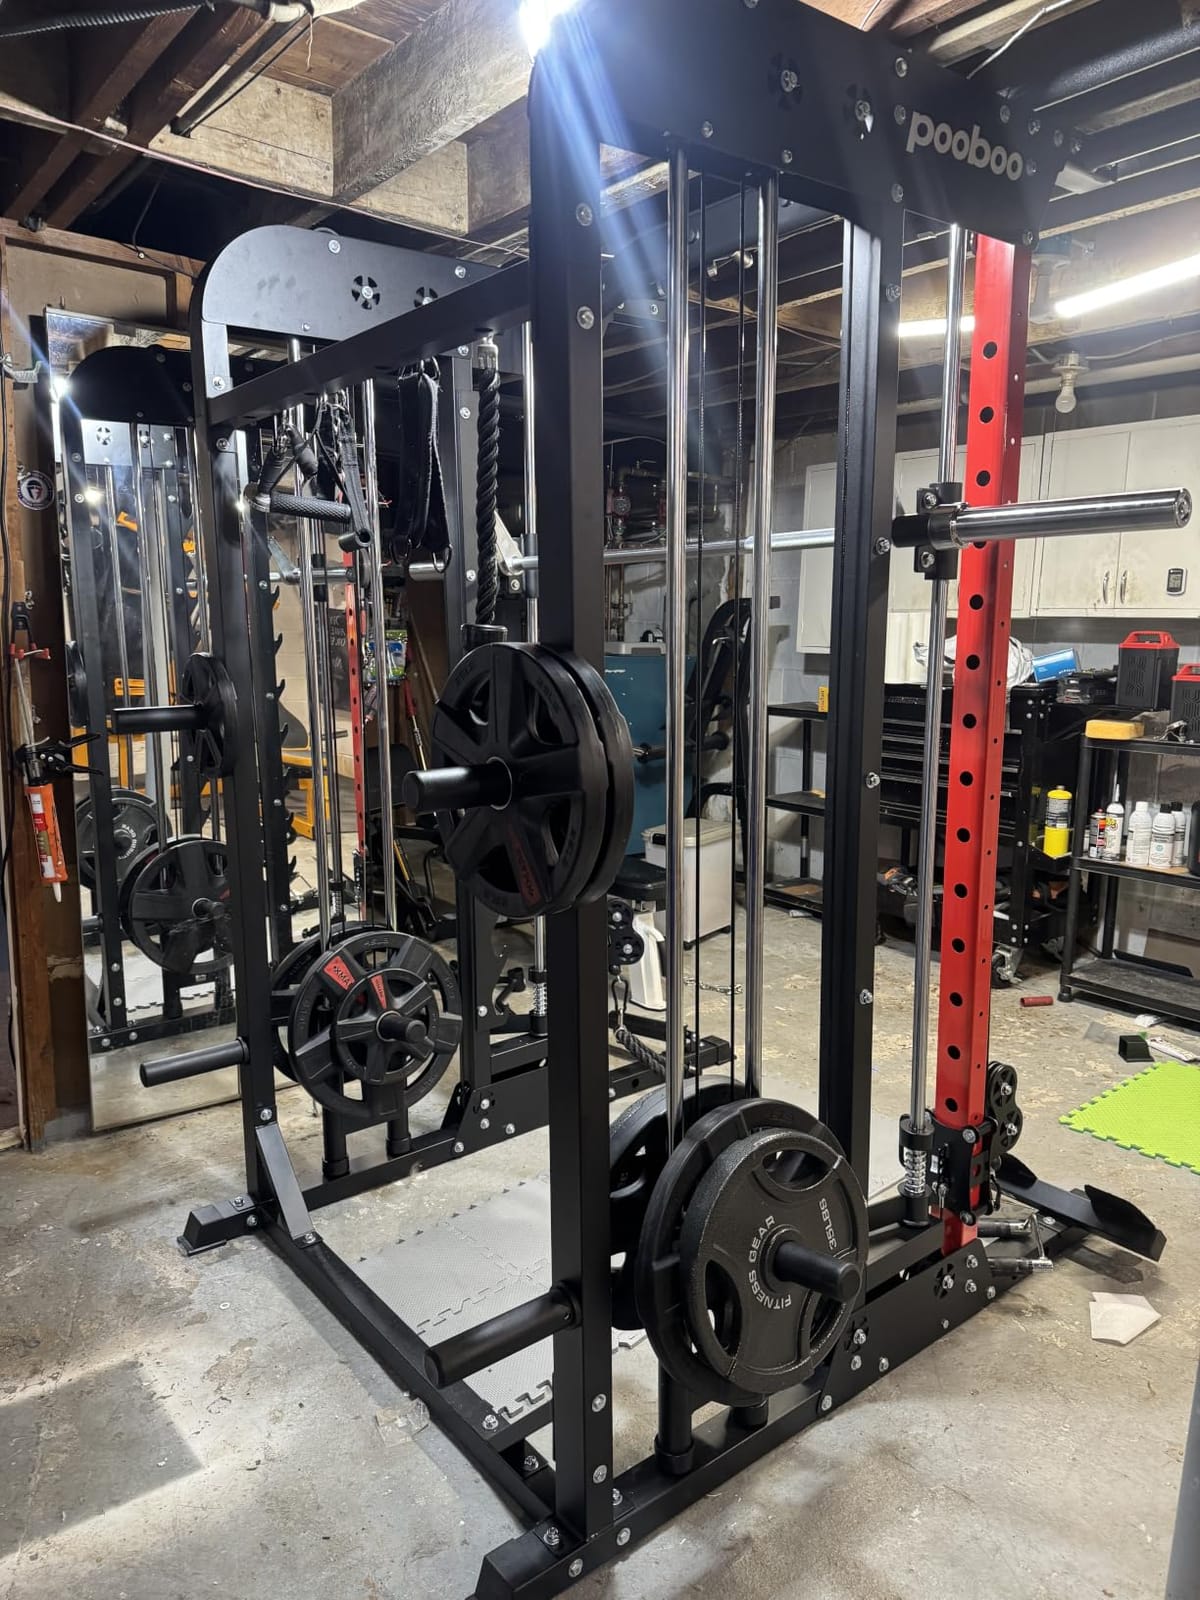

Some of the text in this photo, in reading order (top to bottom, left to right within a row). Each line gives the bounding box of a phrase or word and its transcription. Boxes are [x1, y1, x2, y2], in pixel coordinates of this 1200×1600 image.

[906, 111, 1024, 181] pooboo
[819, 1198, 837, 1250] 35LBS
[748, 1215, 792, 1309] FITNESS GEAR
